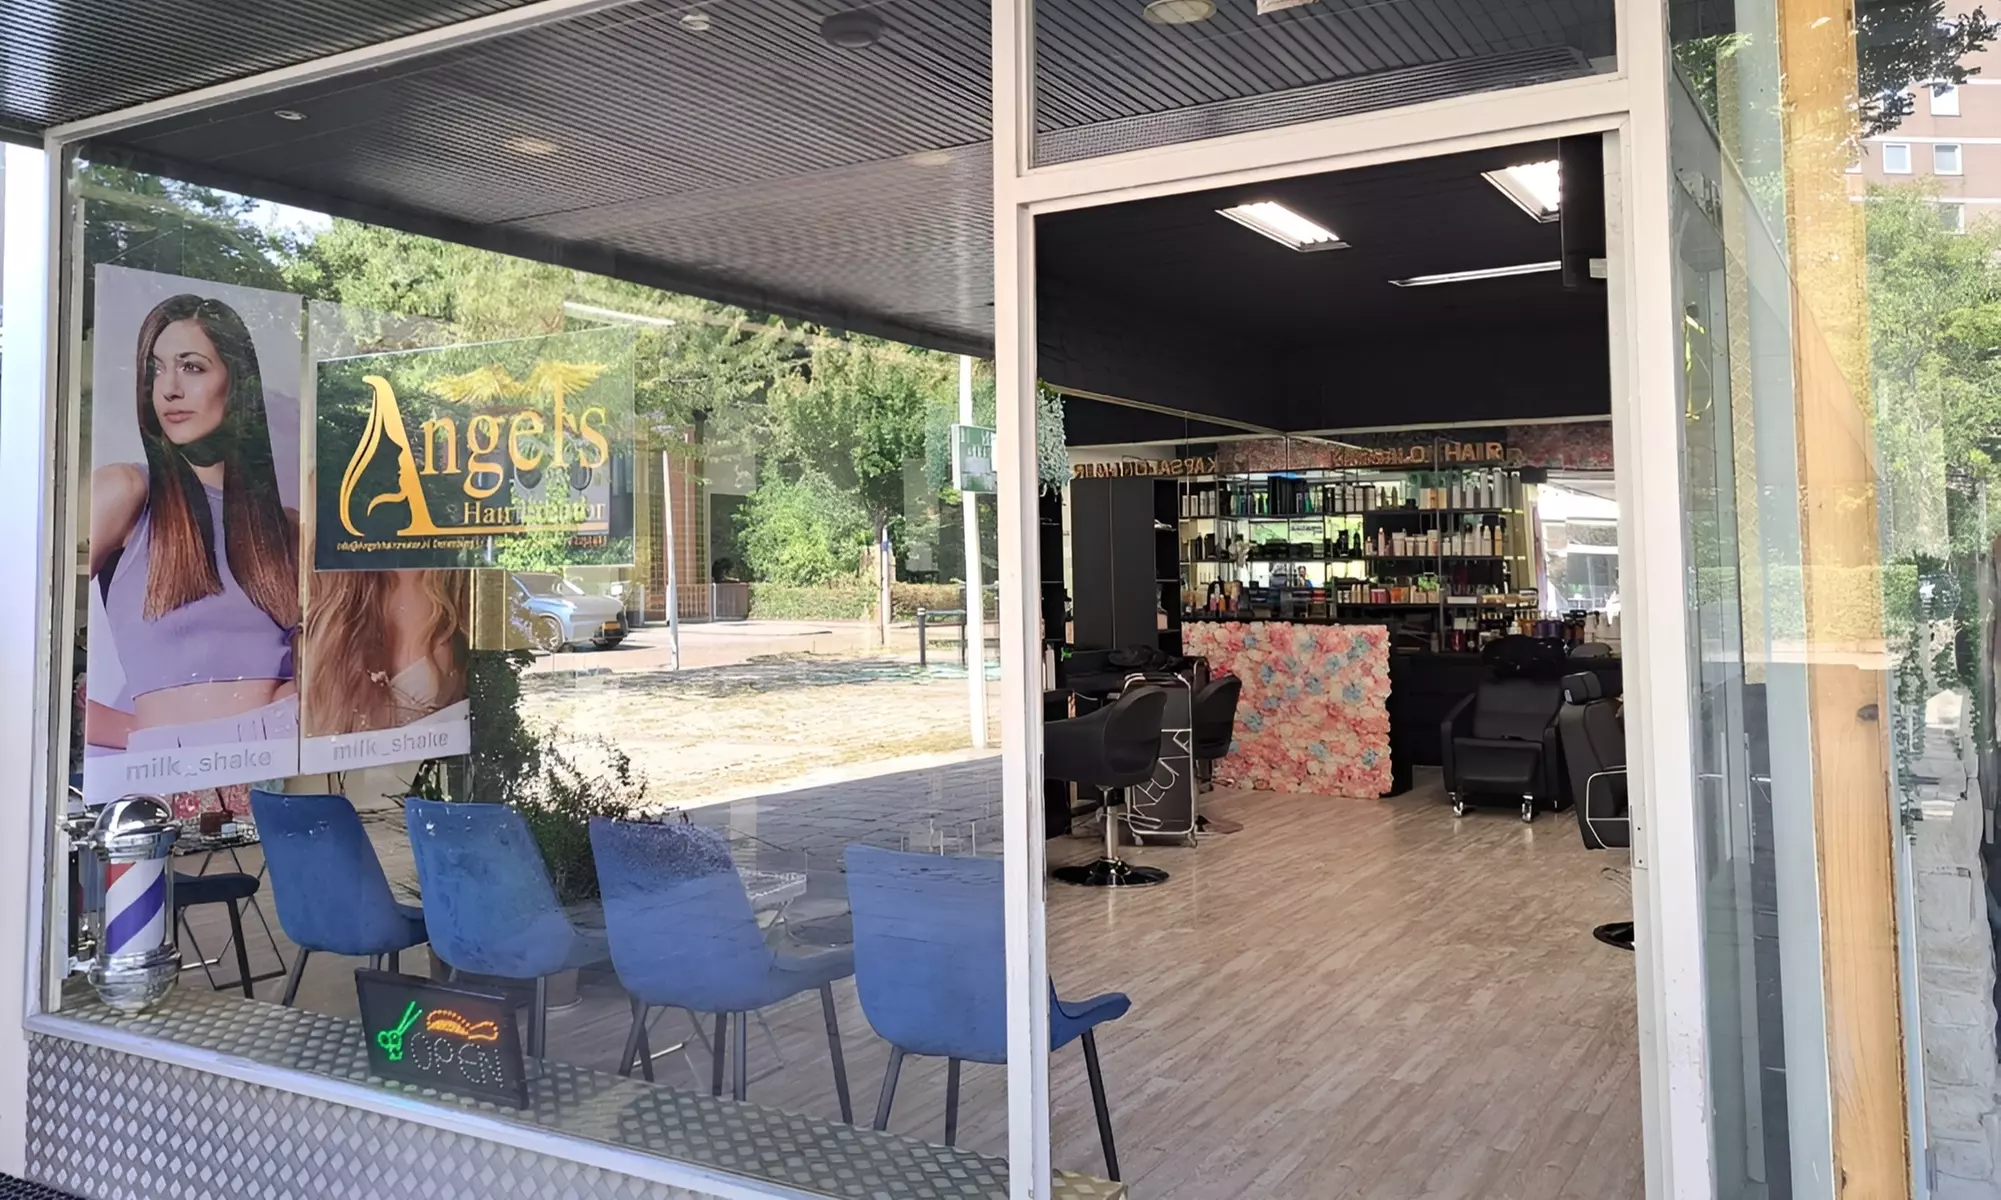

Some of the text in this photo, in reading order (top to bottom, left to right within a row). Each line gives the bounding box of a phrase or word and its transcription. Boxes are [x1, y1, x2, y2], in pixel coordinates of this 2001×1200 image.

[338, 374, 609, 536] Angels
[1446, 441, 1503, 462] HAIR
[332, 730, 448, 761] milk_shake
[126, 750, 272, 780] milk_shake
